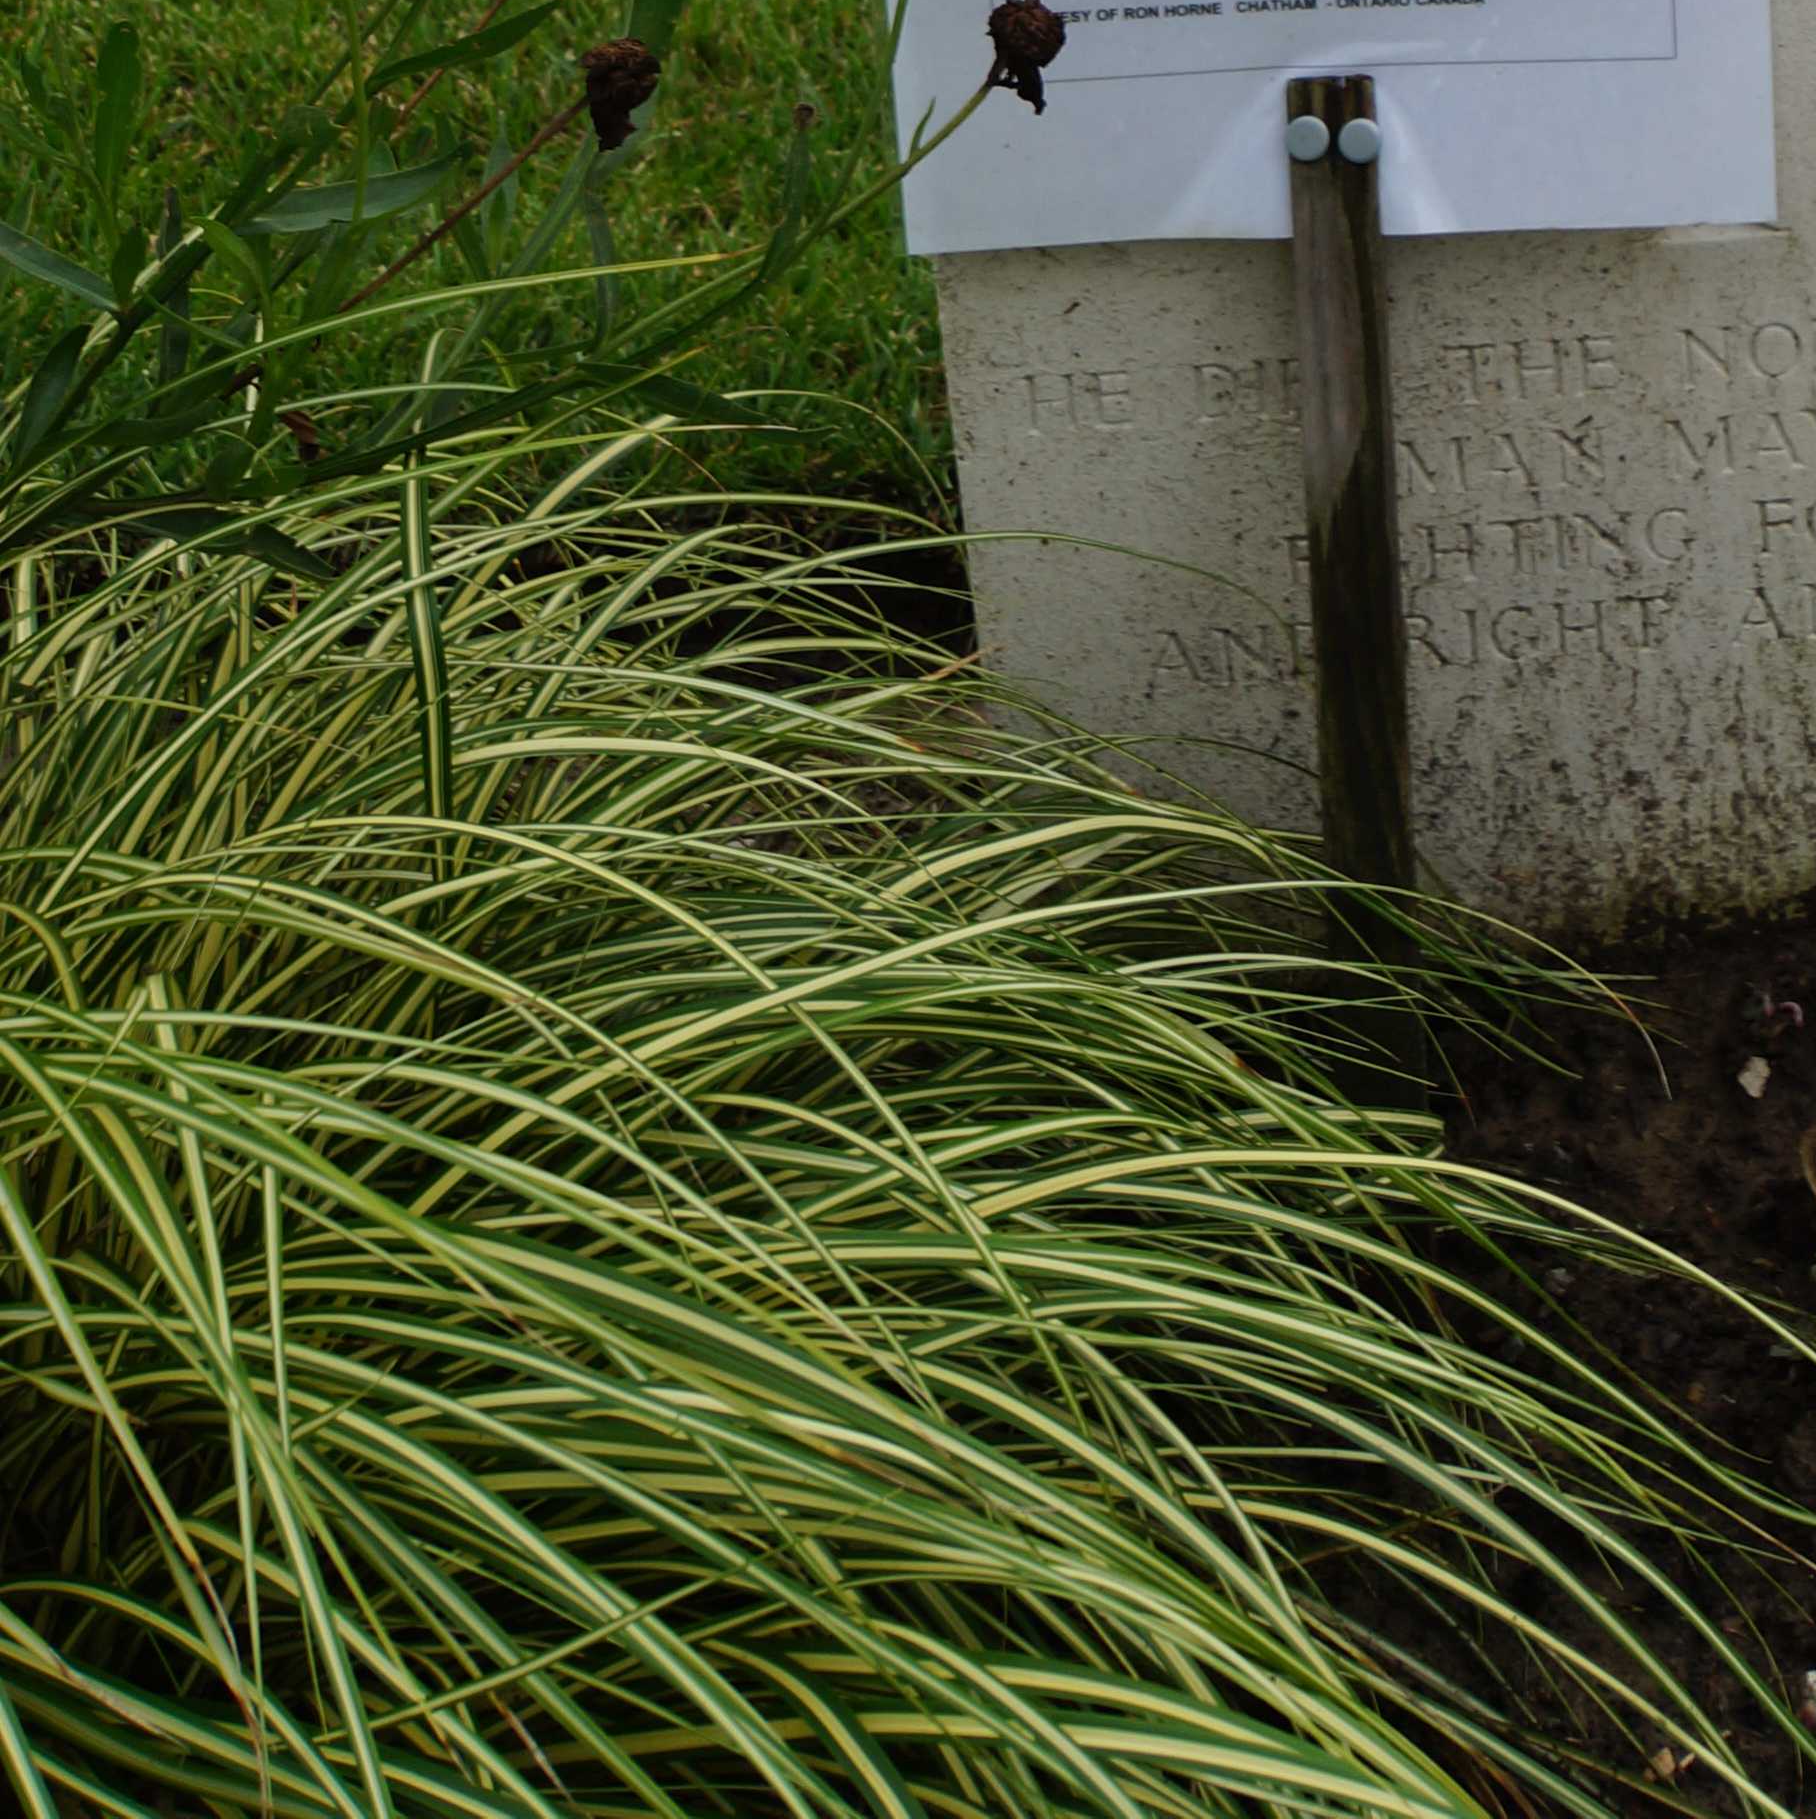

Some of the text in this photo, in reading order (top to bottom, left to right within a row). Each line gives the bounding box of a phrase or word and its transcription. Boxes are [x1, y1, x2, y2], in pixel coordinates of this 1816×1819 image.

[1096, 7, 1120, 22] OF
[1123, 4, 1160, 20] RON
[1163, 1, 1223, 18] HORNE
[1020, 367, 1132, 437] HE
[1441, 333, 1616, 406] THE
[1397, 423, 1603, 497] MAN
[1280, 506, 1698, 583] FHTING
[1400, 593, 1678, 668] RIGHT
